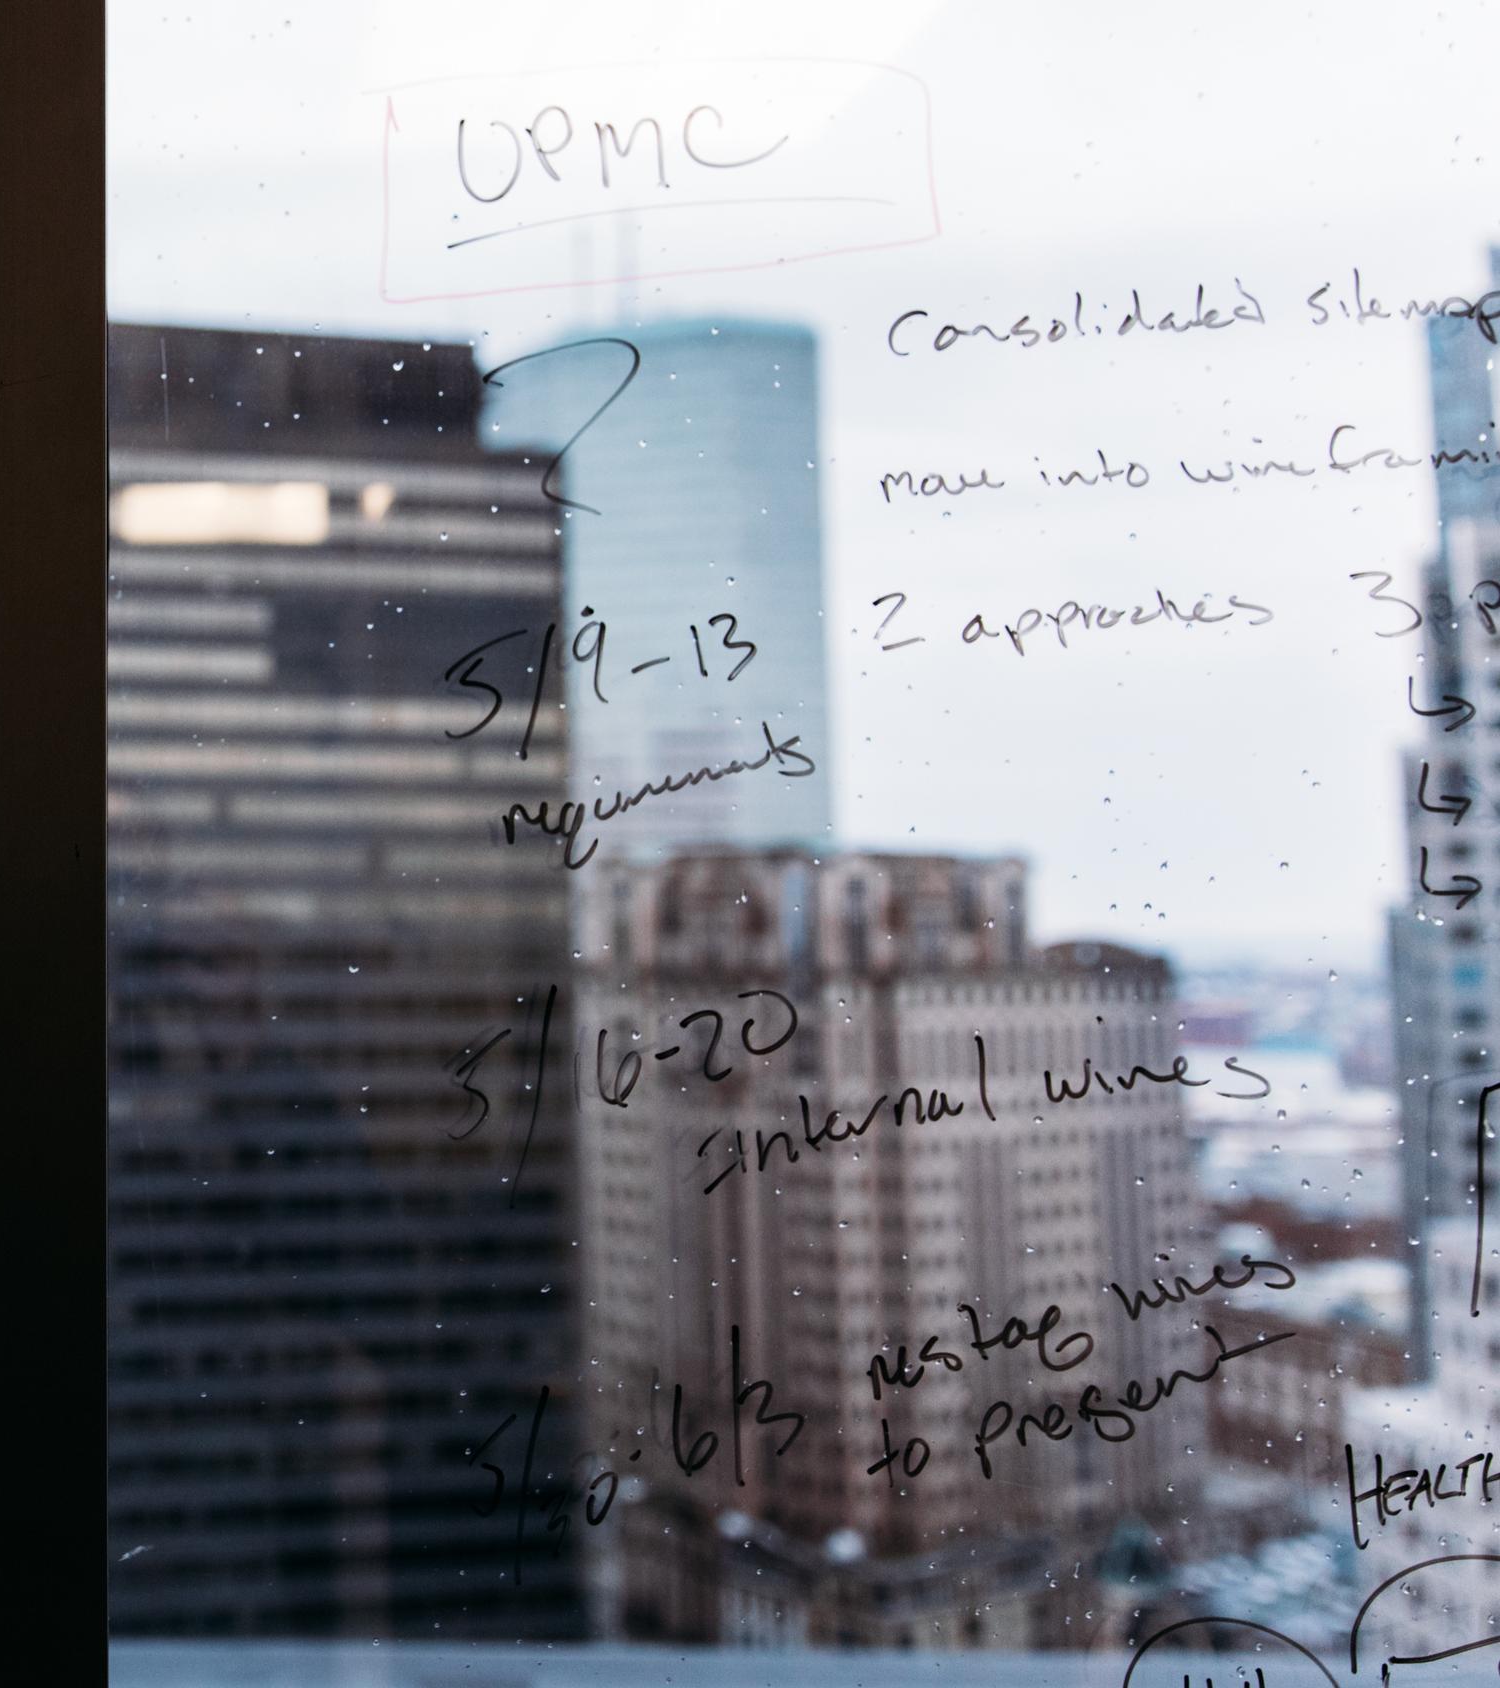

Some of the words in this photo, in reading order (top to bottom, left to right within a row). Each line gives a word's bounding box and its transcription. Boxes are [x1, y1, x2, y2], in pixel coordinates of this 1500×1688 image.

[456, 104, 790, 204] UPMC
[1034, 448, 1150, 488] into
[872, 592, 926, 652] 2
[1349, 570, 1423, 638] 3
[866, 1418, 931, 1489] to
